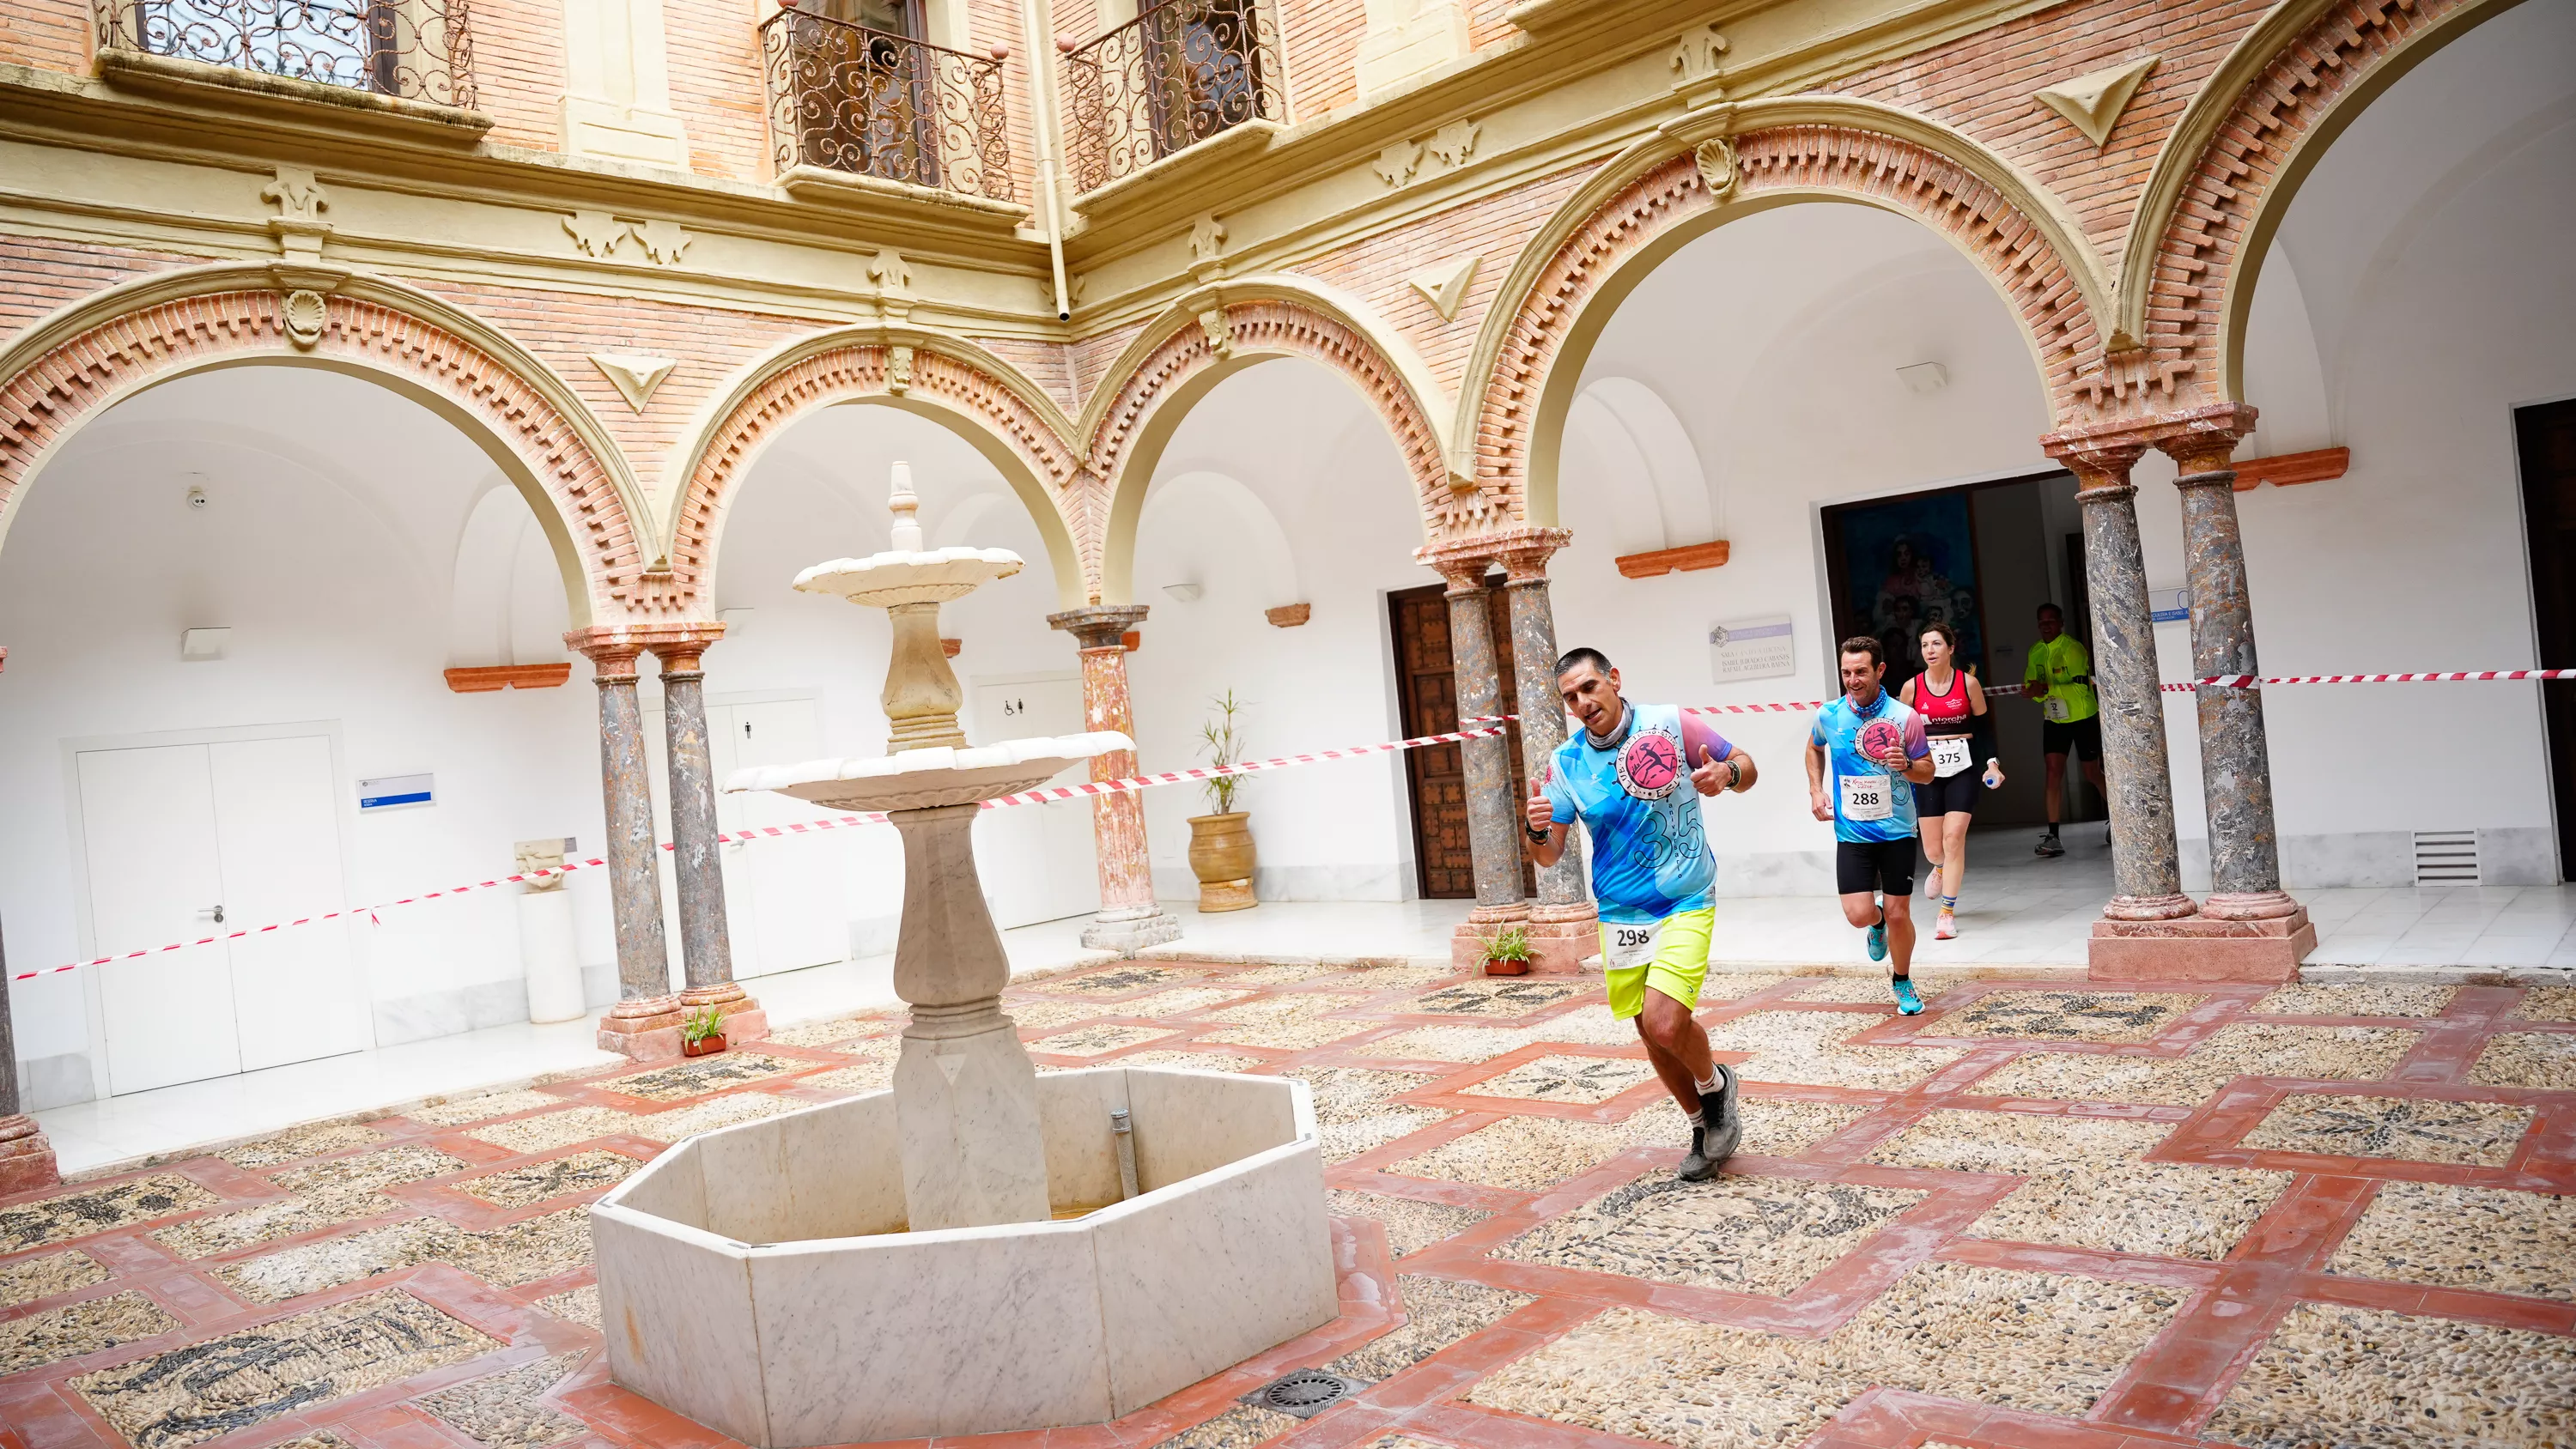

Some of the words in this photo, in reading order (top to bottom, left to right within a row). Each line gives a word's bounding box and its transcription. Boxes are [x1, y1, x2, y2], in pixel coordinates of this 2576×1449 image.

[1744, 663, 1771, 671] AGUILERA
[1938, 752, 1961, 765] 375
[1619, 766, 1638, 795] CLUB
[1852, 792, 1880, 805] 288
[1633, 797, 1704, 869] 35
[1617, 929, 1650, 947] 298
